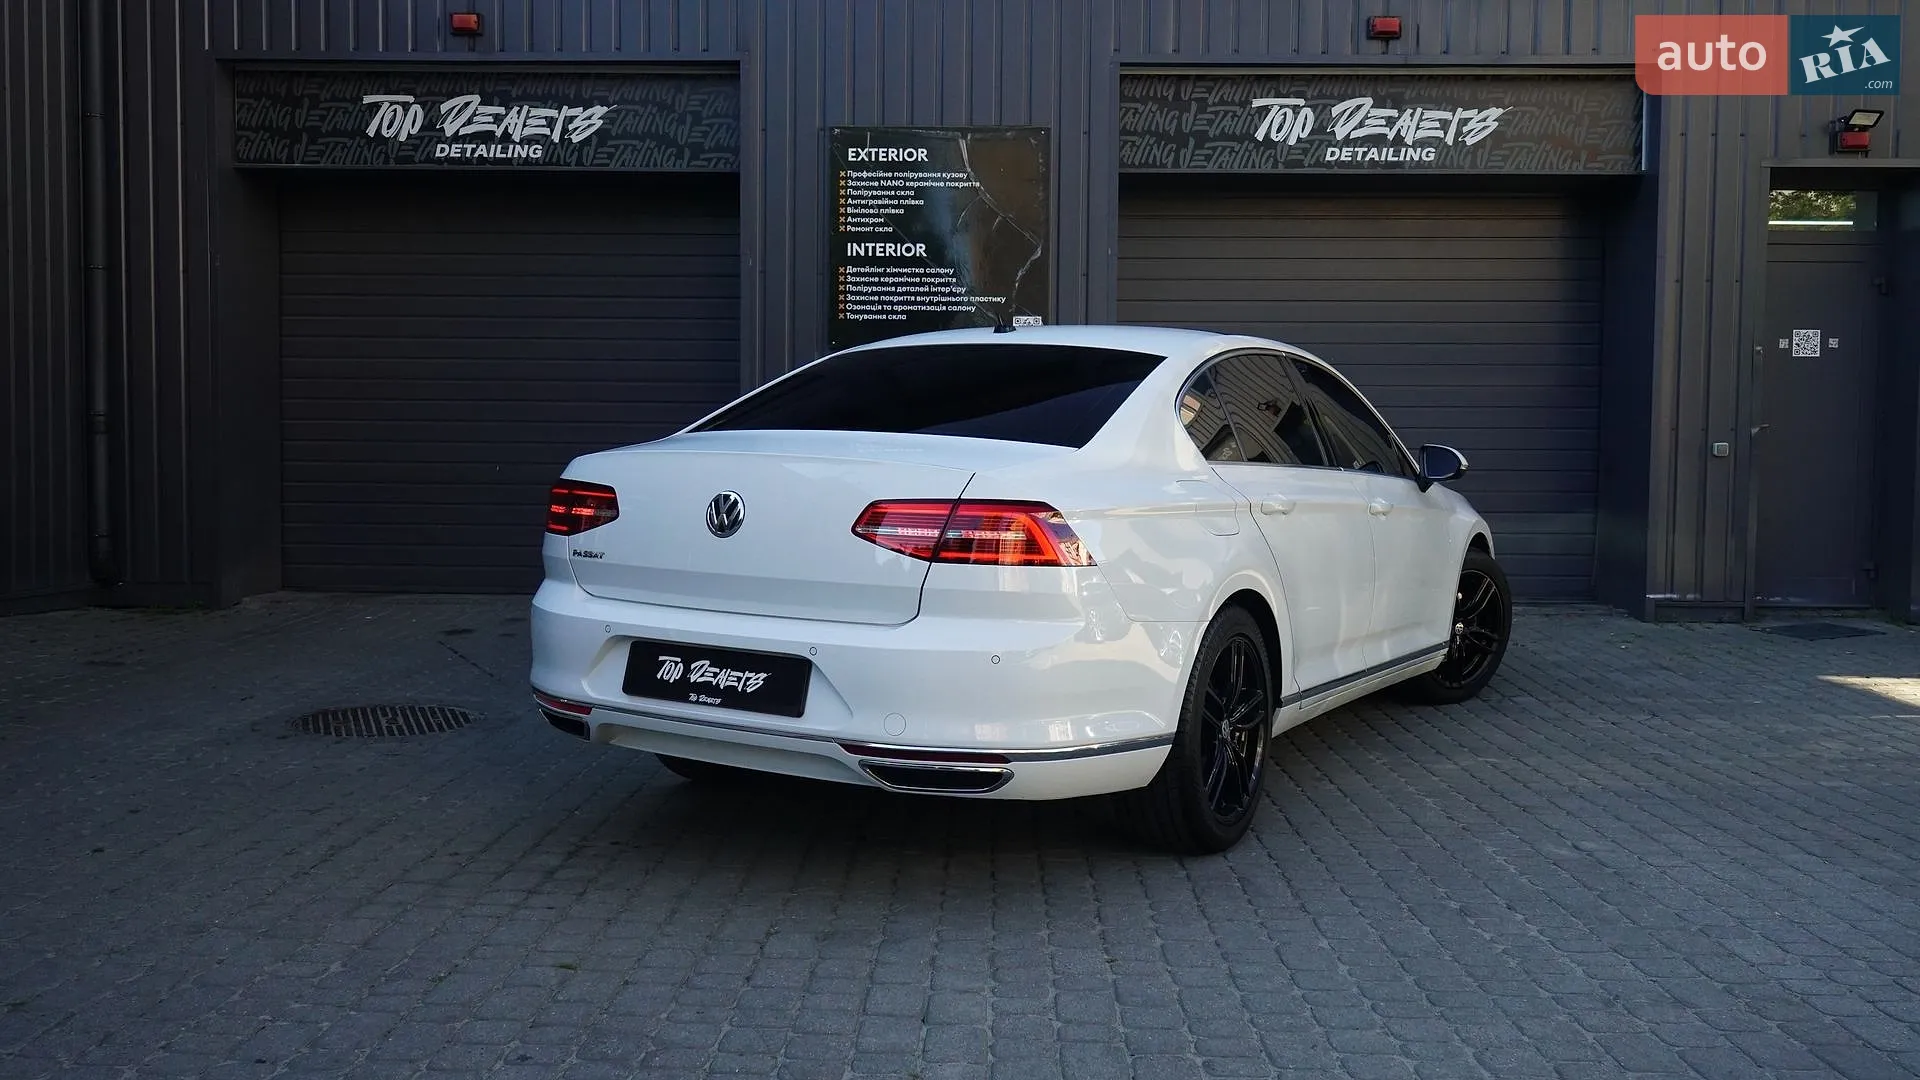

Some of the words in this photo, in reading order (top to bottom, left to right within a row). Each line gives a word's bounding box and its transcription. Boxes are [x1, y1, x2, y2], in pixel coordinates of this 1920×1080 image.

[435, 144, 542, 158] DETAILING
[847, 148, 929, 162] EXTERIOR
[1325, 147, 1436, 161] DETAILING
[847, 170, 892, 179] Професійне
[893, 171, 941, 179] полірування
[905, 180, 944, 189] керамічне
[945, 181, 980, 189] покриття
[847, 189, 895, 197] Полірування
[847, 198, 898, 206] Антигравійна
[846, 216, 884, 224] Антихром
[847, 225, 873, 233] Ремонт
[847, 242, 927, 257] INTERIOR
[846, 266, 885, 274] Детейлінг
[886, 266, 925, 274] хімчистка
[925, 267, 954, 275] салону
[846, 275, 879, 283] Захисне
[880, 275, 921, 284] керамічне
[921, 276, 957, 284] покриття
[846, 285, 895, 293] Полірування
[896, 285, 930, 293] деталей
[880, 294, 915, 303] покриття
[916, 294, 969, 303] внутрішнього
[969, 295, 1007, 303] пластику
[846, 303, 882, 311] Озонація
[893, 303, 947, 312] ароматизація
[947, 304, 977, 312] салону
[846, 313, 887, 321] Тонування
[572, 549, 605, 559] PASSAT
